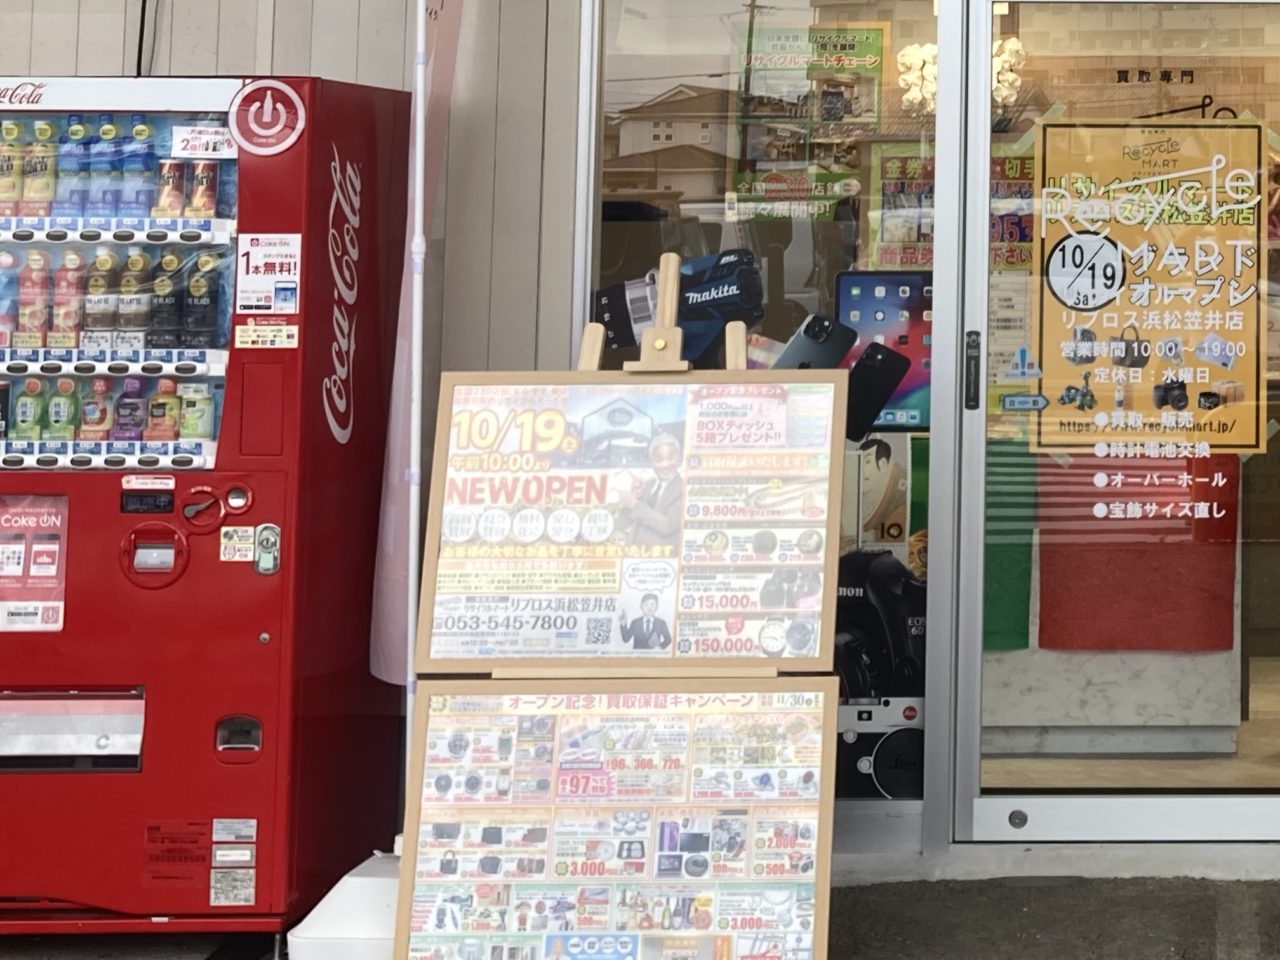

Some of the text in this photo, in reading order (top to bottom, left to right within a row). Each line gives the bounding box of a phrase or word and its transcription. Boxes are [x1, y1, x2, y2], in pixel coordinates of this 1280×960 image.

[1116, 70, 1195, 84] 買取専門
[1142, 159, 1179, 169] MART
[322, 142, 363, 445] Coca-Cola
[685, 284, 740, 304] makita
[1061, 310, 1245, 330] リプロス浜松笠井店
[1060, 341, 1126, 358] 営業時間
[1131, 342, 1175, 357] 10:00
[1201, 342, 1246, 357] 19:00
[1109, 442, 1211, 458] 時計電池交換
[1110, 472, 1228, 488] オーバーホール
[447, 475, 609, 506] NEW OPEN
[1109, 502, 1227, 519] 宝飾サイズ直し
[1, 514, 37, 527] Coke
[444, 615, 578, 631] 053-545-7800
